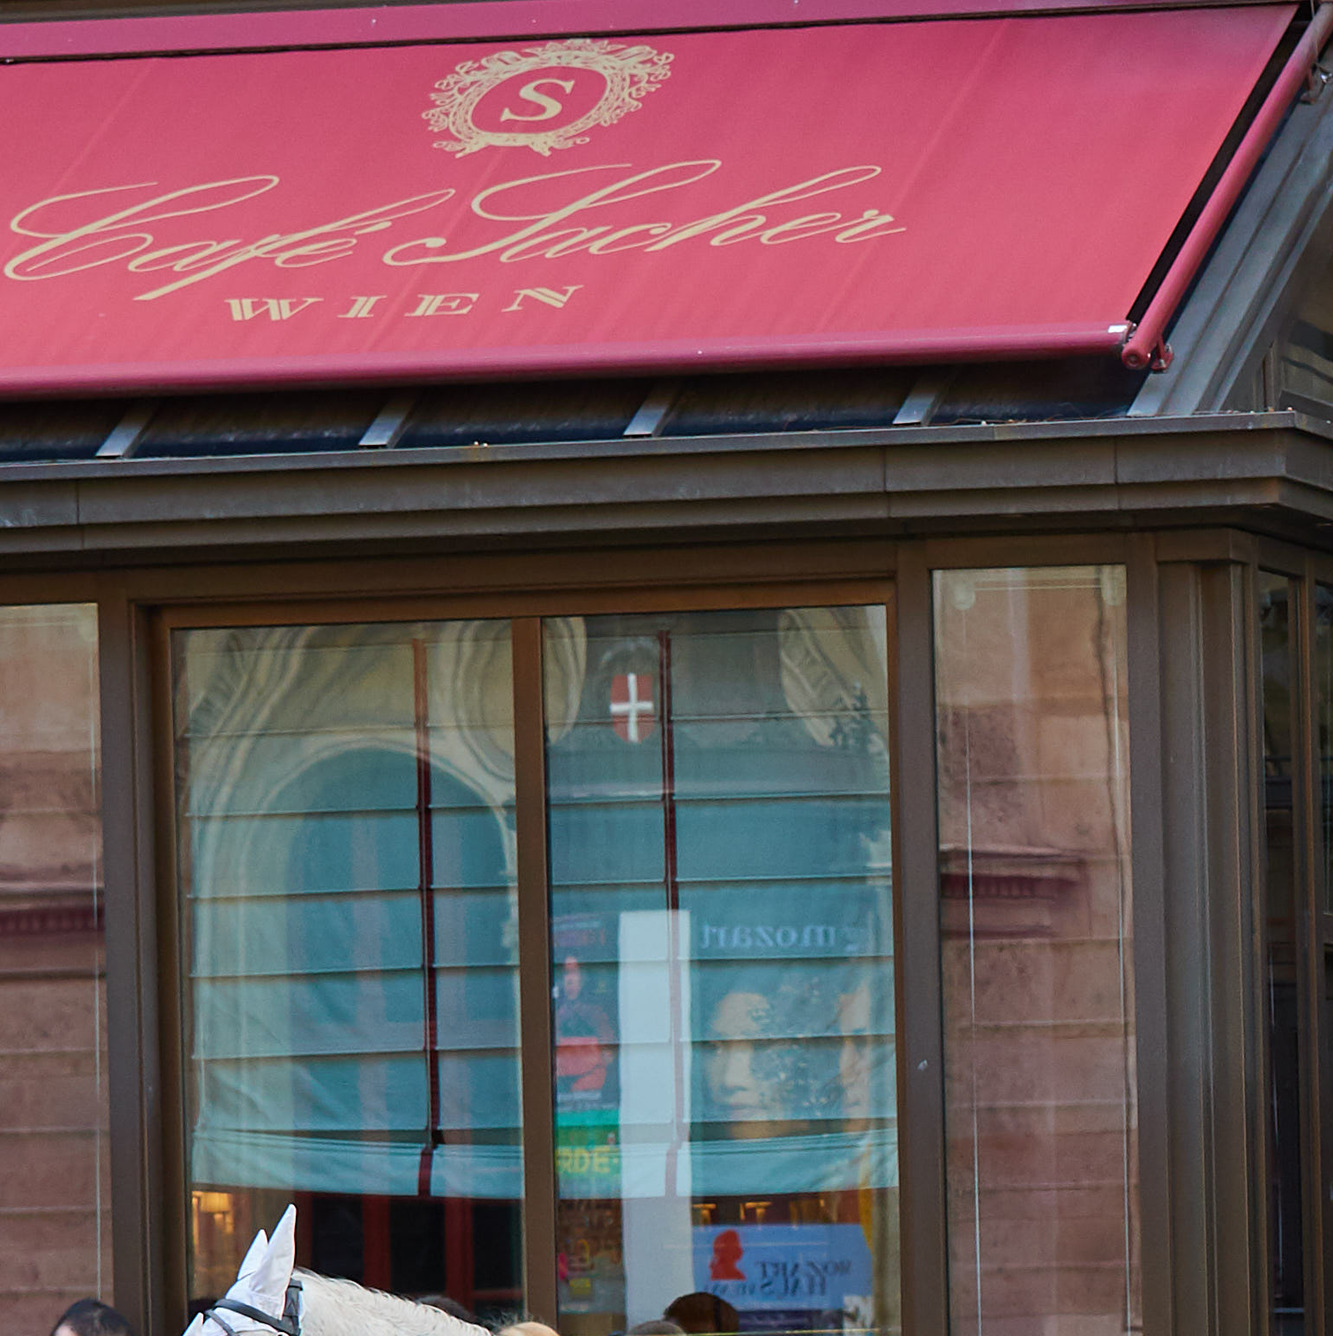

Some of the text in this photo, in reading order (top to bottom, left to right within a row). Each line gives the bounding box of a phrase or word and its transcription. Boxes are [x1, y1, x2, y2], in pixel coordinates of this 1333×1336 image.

[499, 77, 576, 122] S
[3, 158, 908, 301] Café Sacher
[222, 284, 586, 323] WIEN
